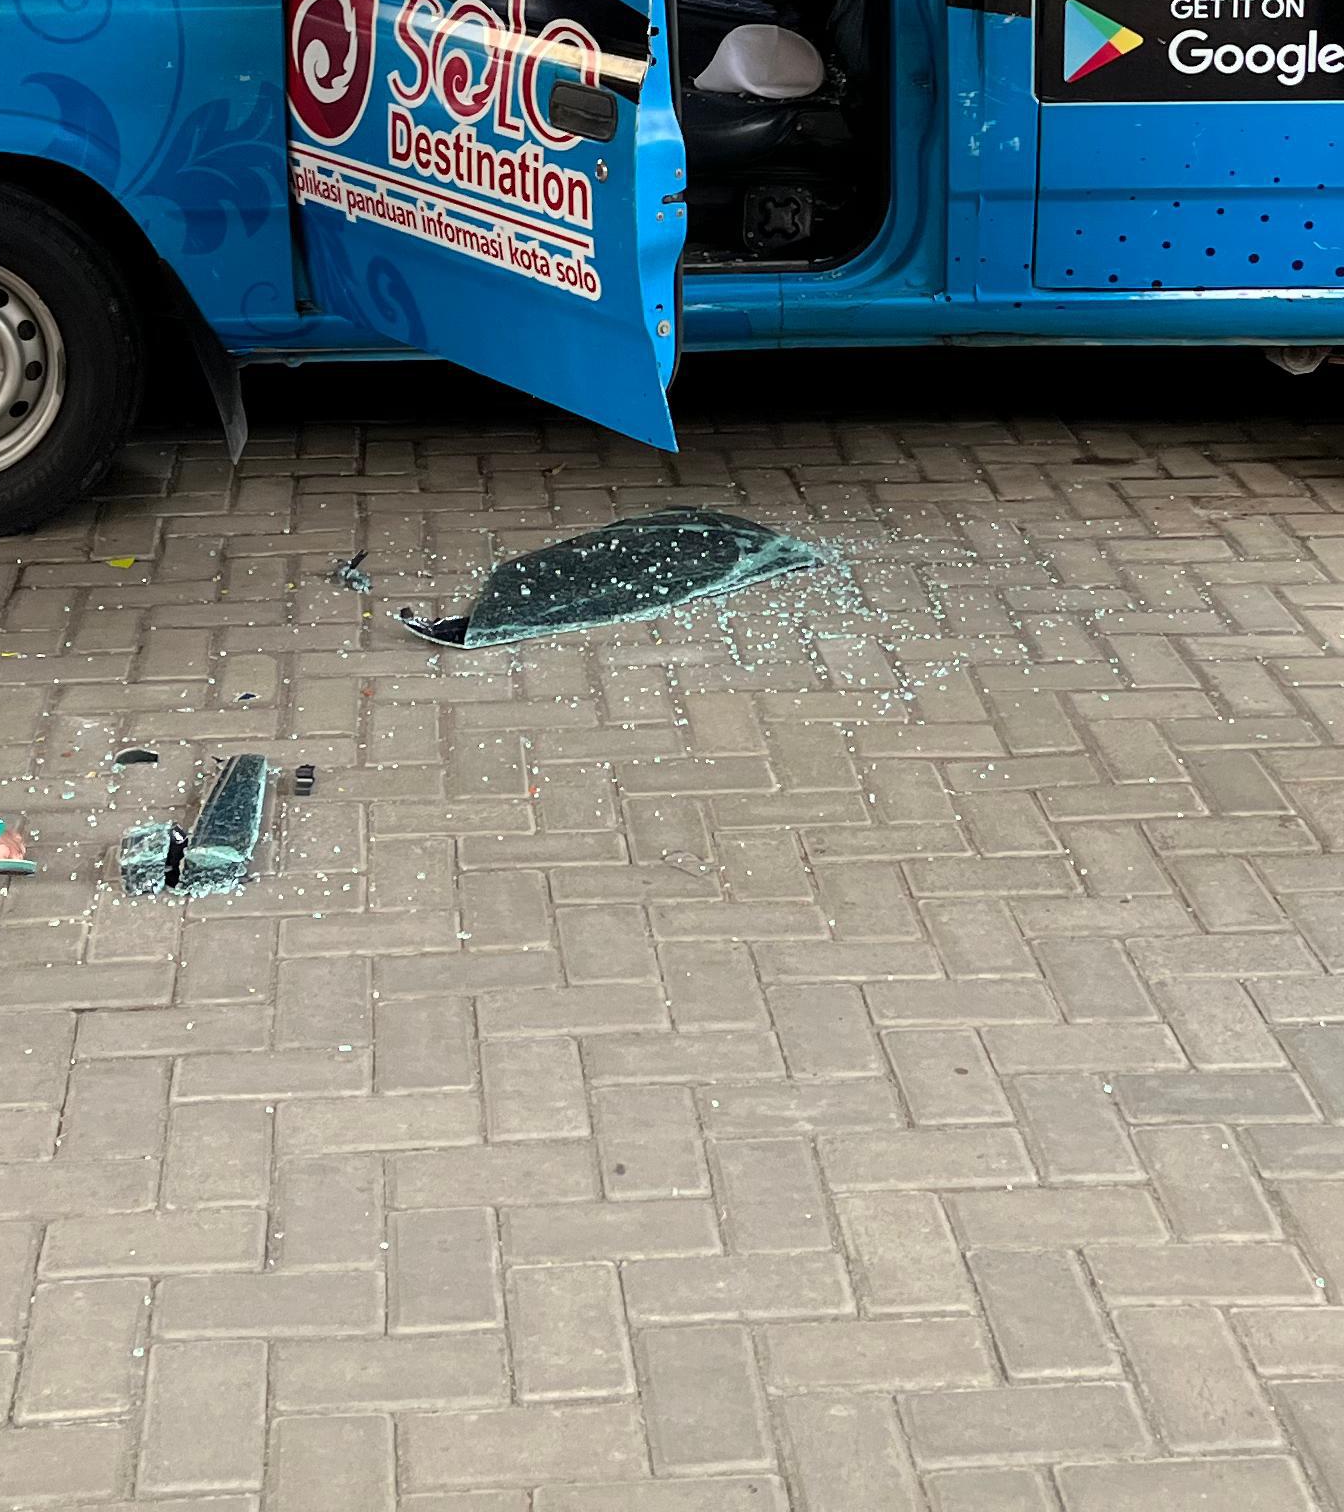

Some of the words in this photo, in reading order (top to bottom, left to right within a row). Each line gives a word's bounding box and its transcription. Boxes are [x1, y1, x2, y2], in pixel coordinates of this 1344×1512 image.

[390, 110, 590, 222] Destination
[293, 167, 342, 204] plikasi
[346, 190, 417, 229] panduan
[419, 206, 505, 261] informasi
[507, 235, 551, 277] kota
[555, 259, 598, 293] solo
